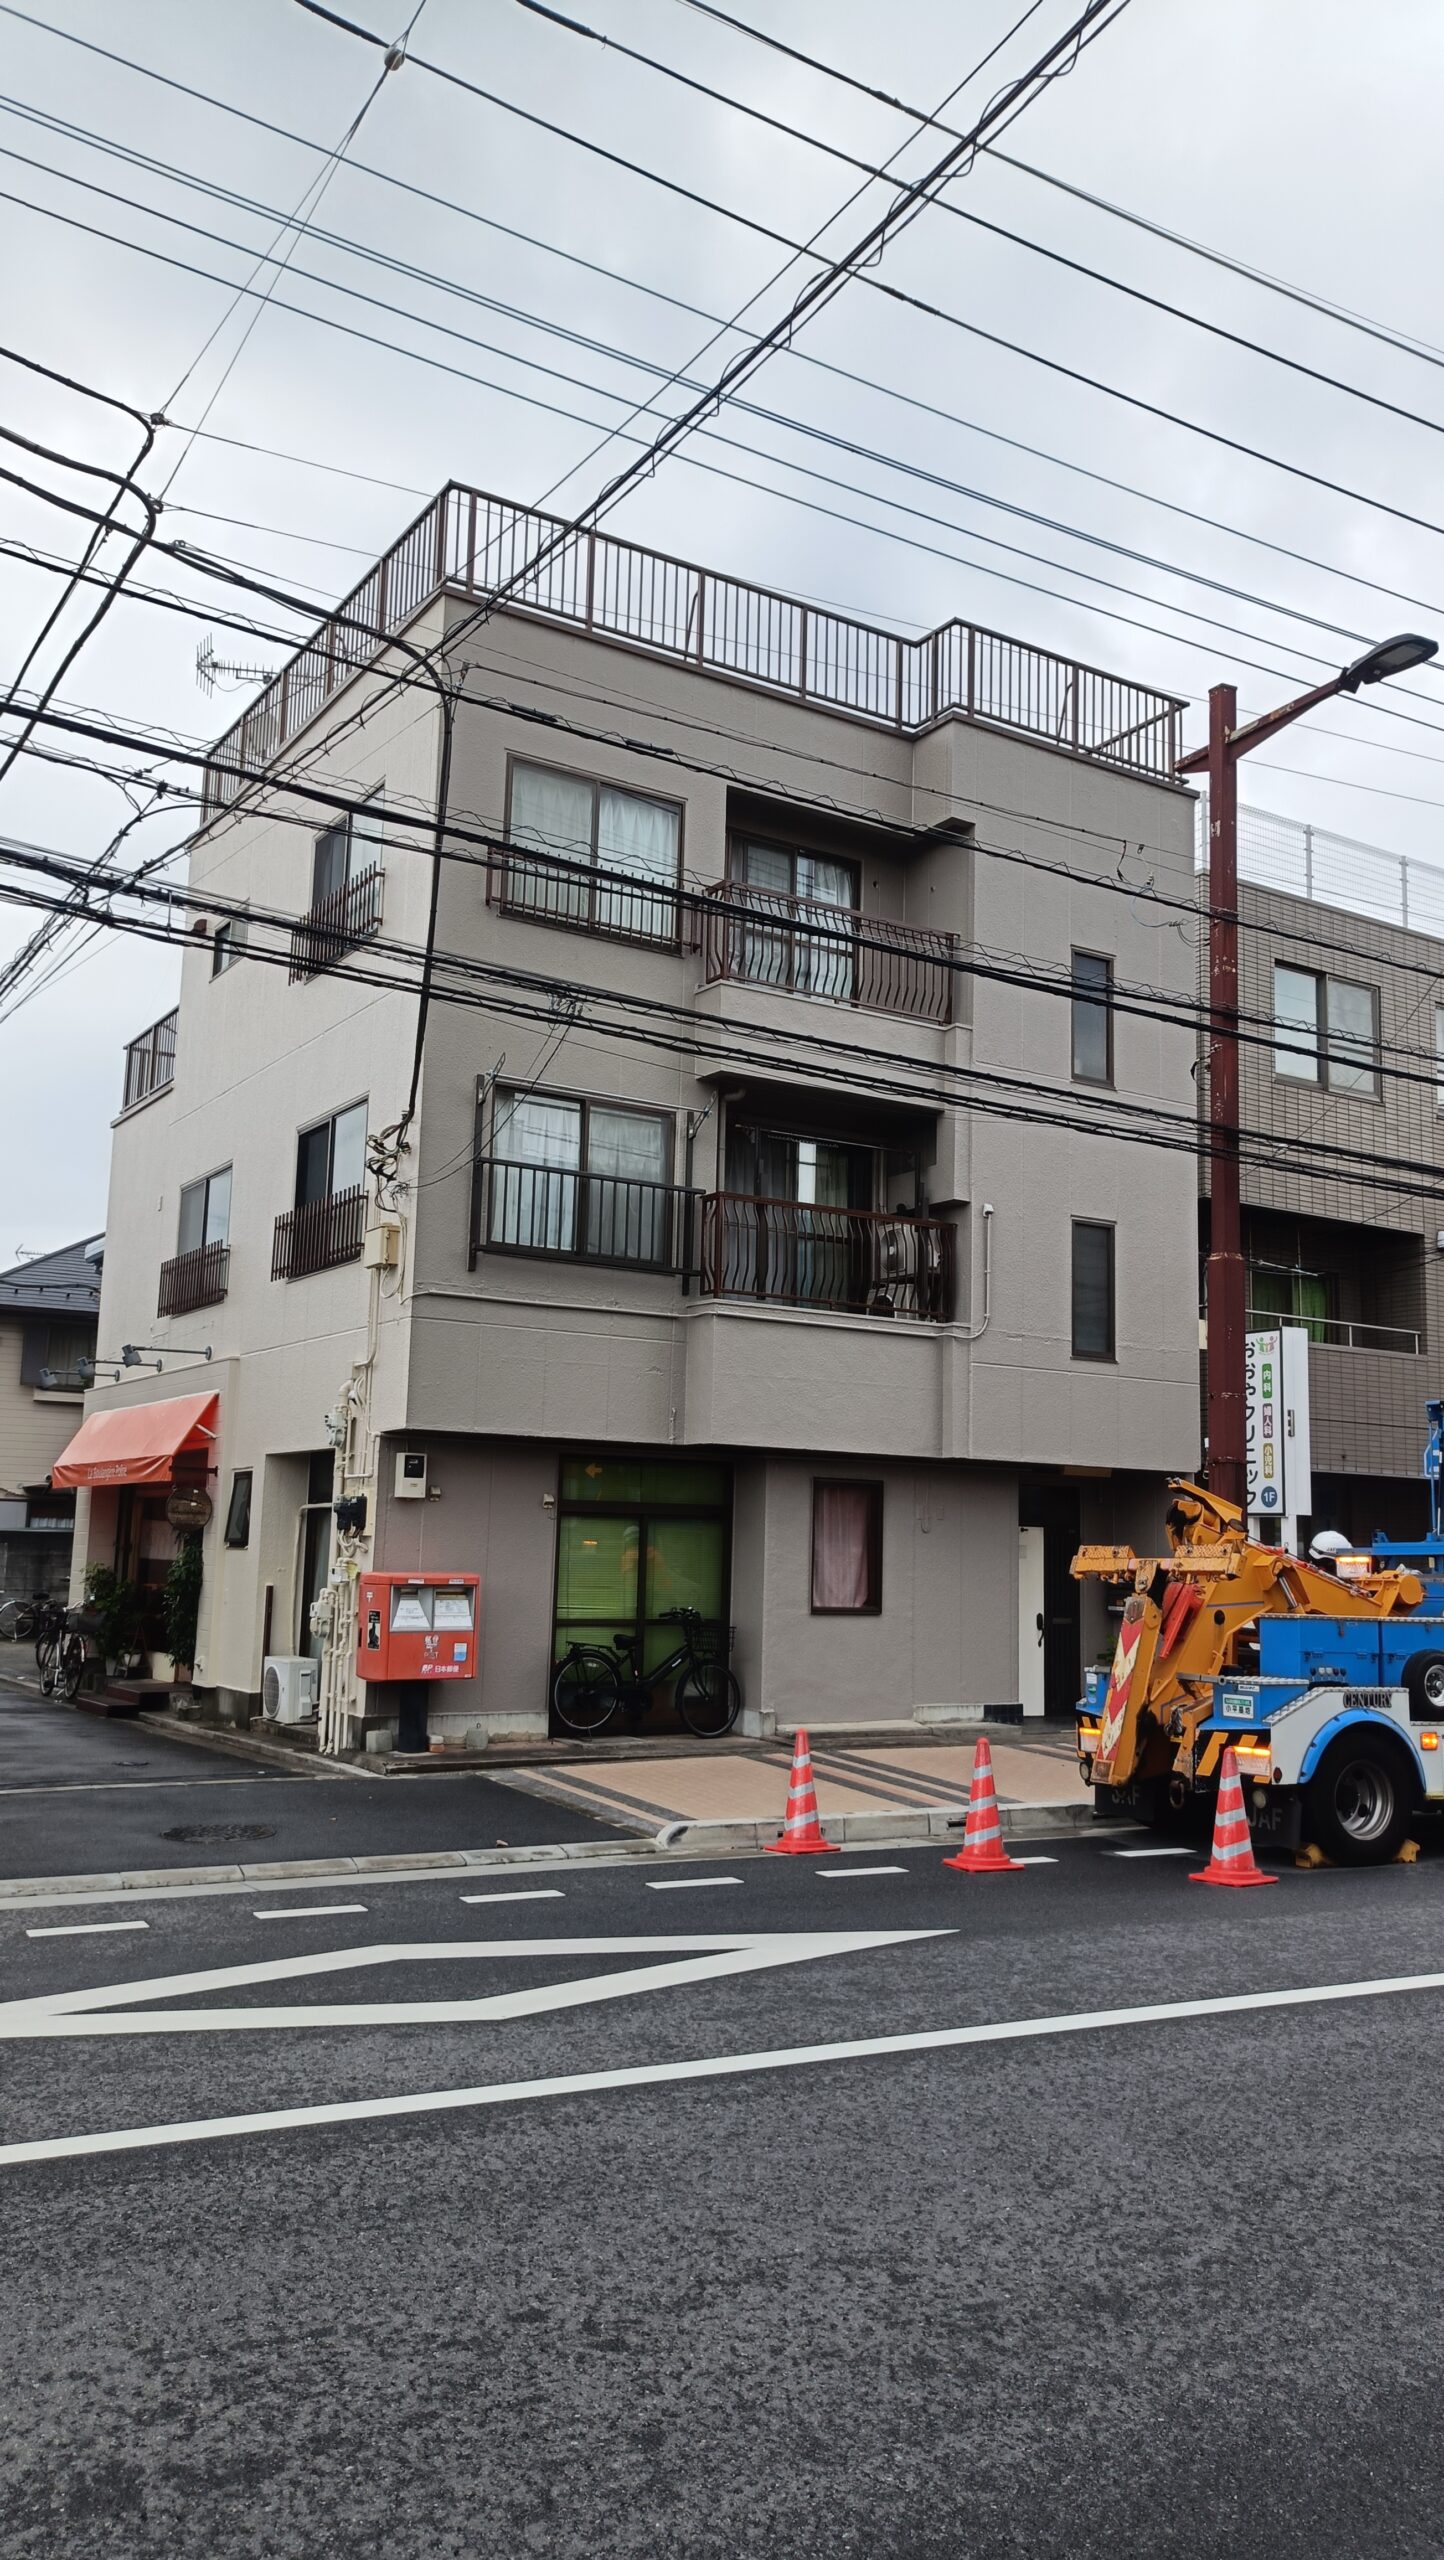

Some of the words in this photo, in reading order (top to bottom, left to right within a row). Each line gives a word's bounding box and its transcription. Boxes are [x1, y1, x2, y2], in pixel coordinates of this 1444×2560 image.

[1263, 1370, 1272, 1392] 内科
[1263, 1405, 1272, 1436] 婦人科
[1264, 1445, 1273, 1475] 小児科
[1263, 1491, 1276, 1503] 1F
[1343, 1692, 1392, 1708] CENTURY
[1246, 1807, 1283, 1831] JAF
